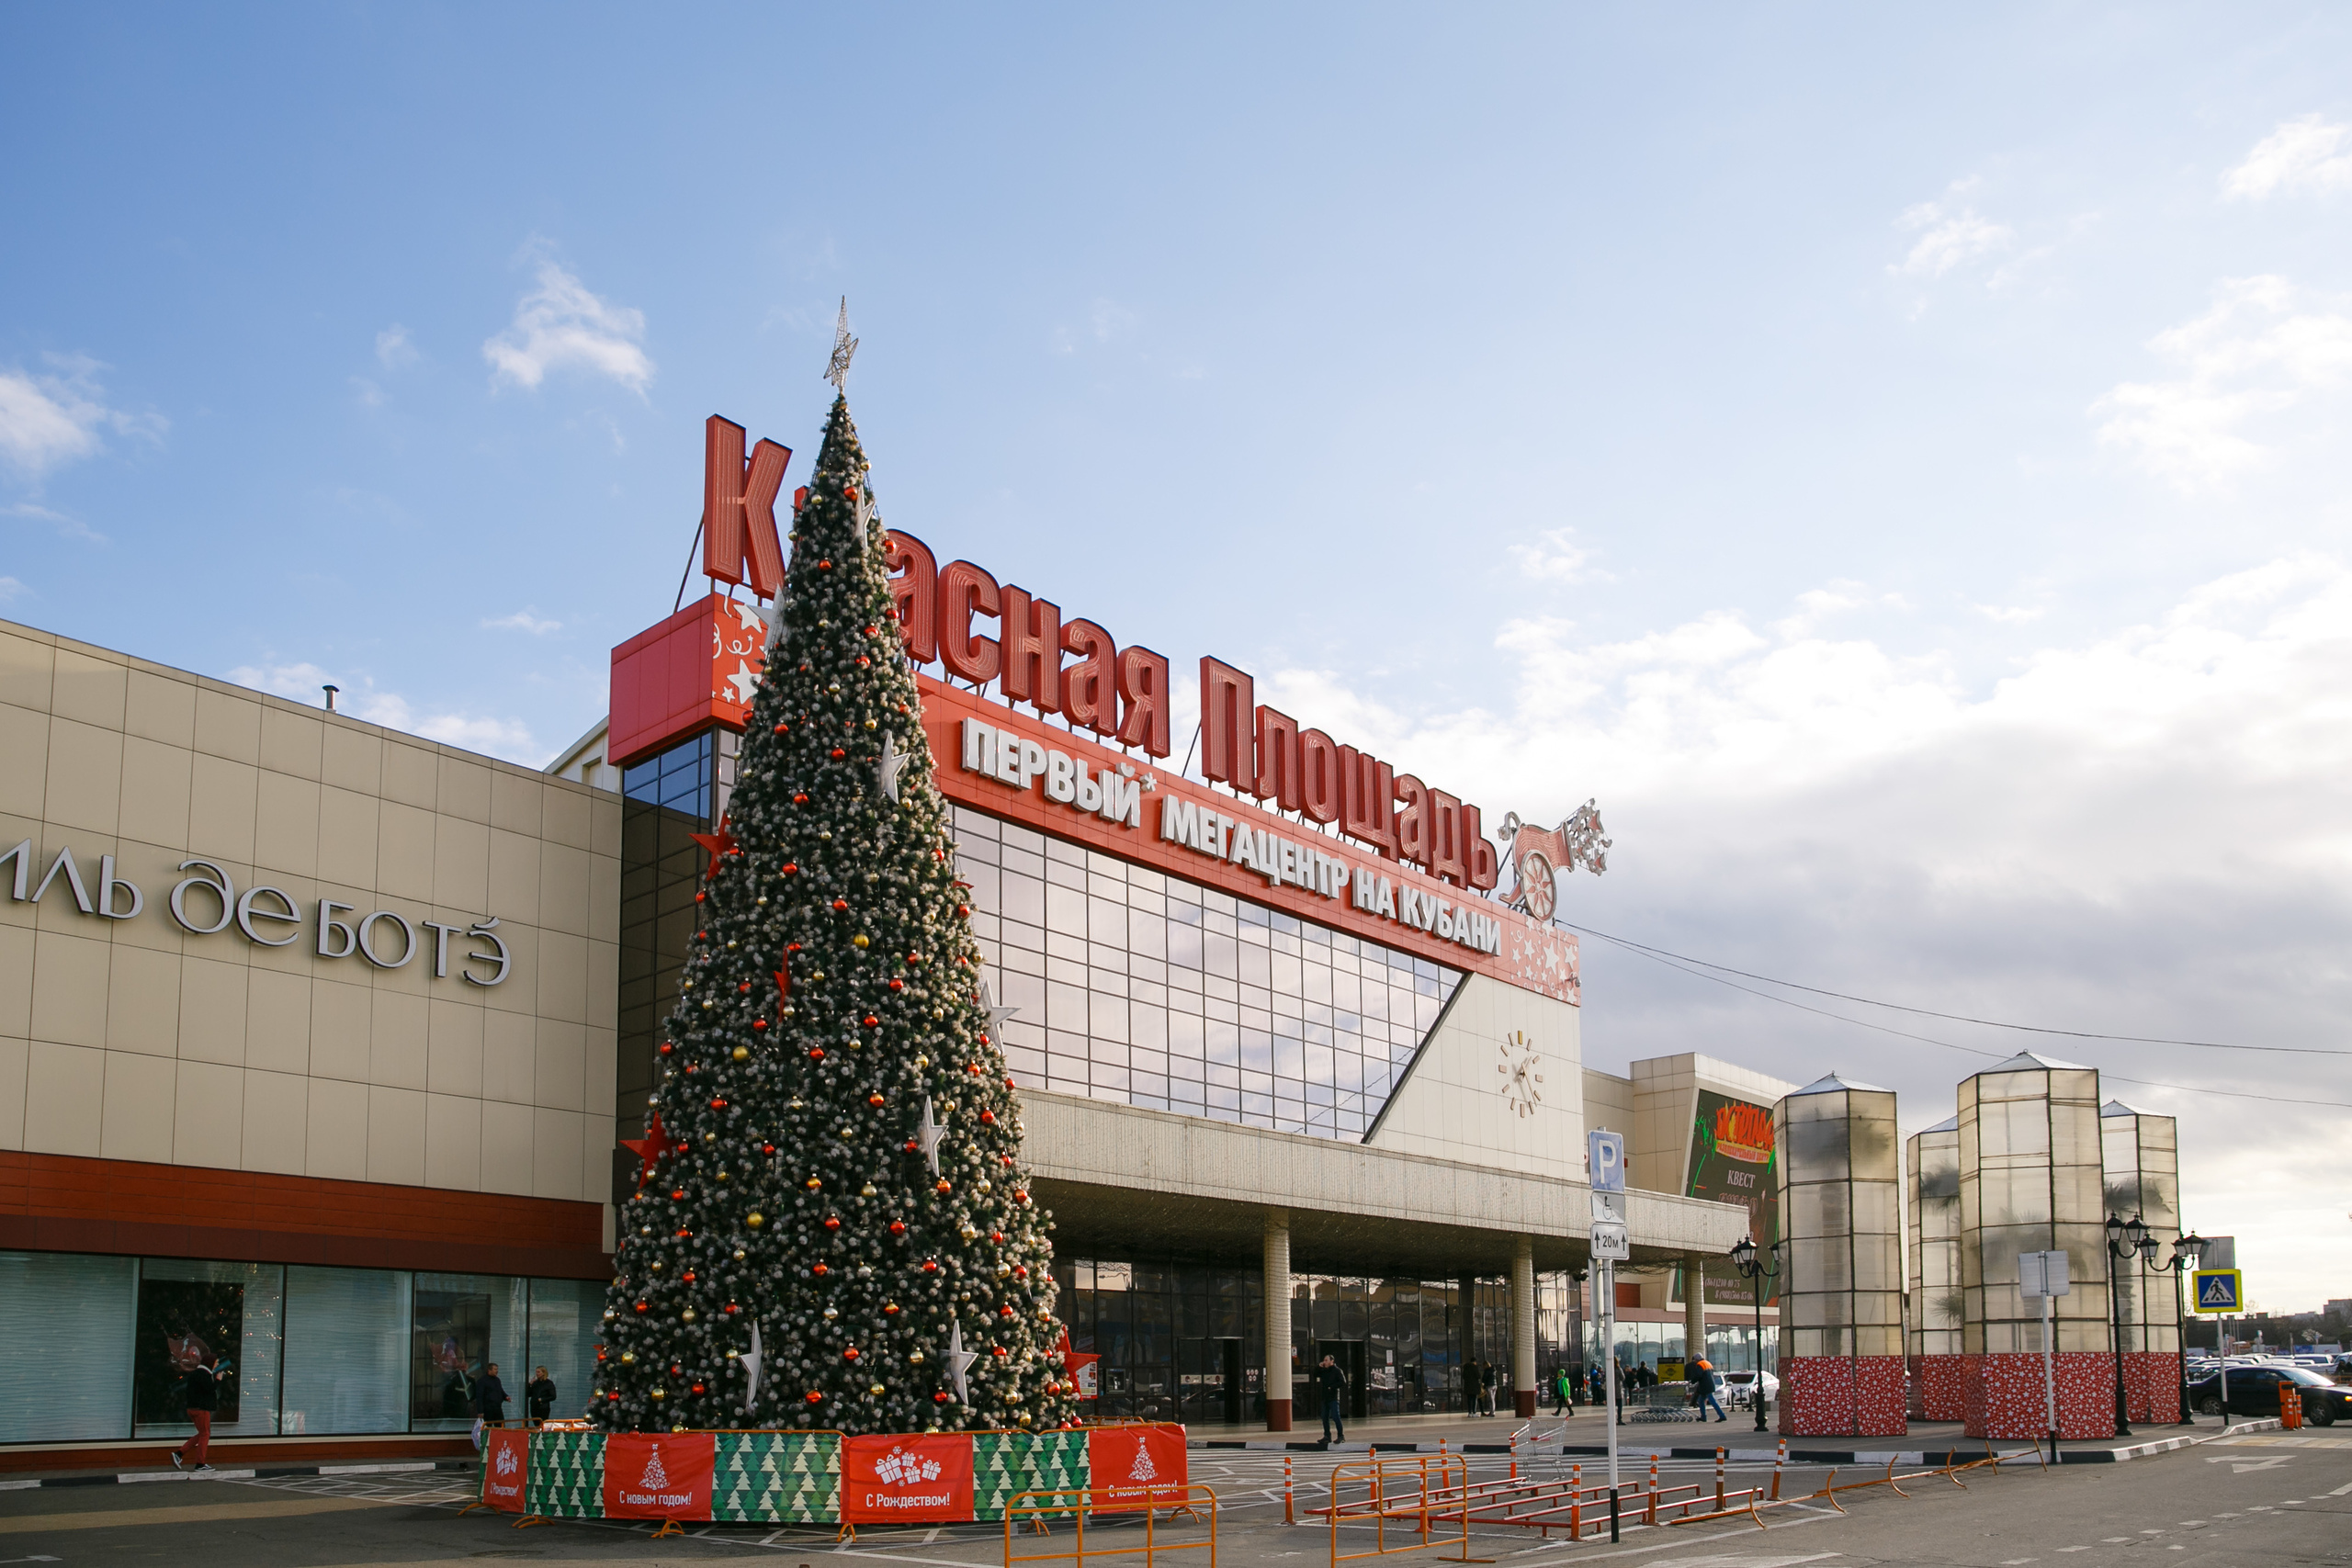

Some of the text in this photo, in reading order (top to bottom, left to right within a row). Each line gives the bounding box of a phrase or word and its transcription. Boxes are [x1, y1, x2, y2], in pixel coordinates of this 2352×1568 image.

[703, 413, 1498, 891] Касная Площадь
[1160, 794, 1350, 900] МЕГАЦЕНТР
[1351, 866, 1396, 920] НА
[1397, 883, 1502, 957] КУБАНИ
[1599, 1139, 1617, 1185] P
[1727, 1169, 1756, 1189] КВЕСТ
[619, 1490, 692, 1506] С новым годом!
[865, 1492, 950, 1508] С Рождеством!
